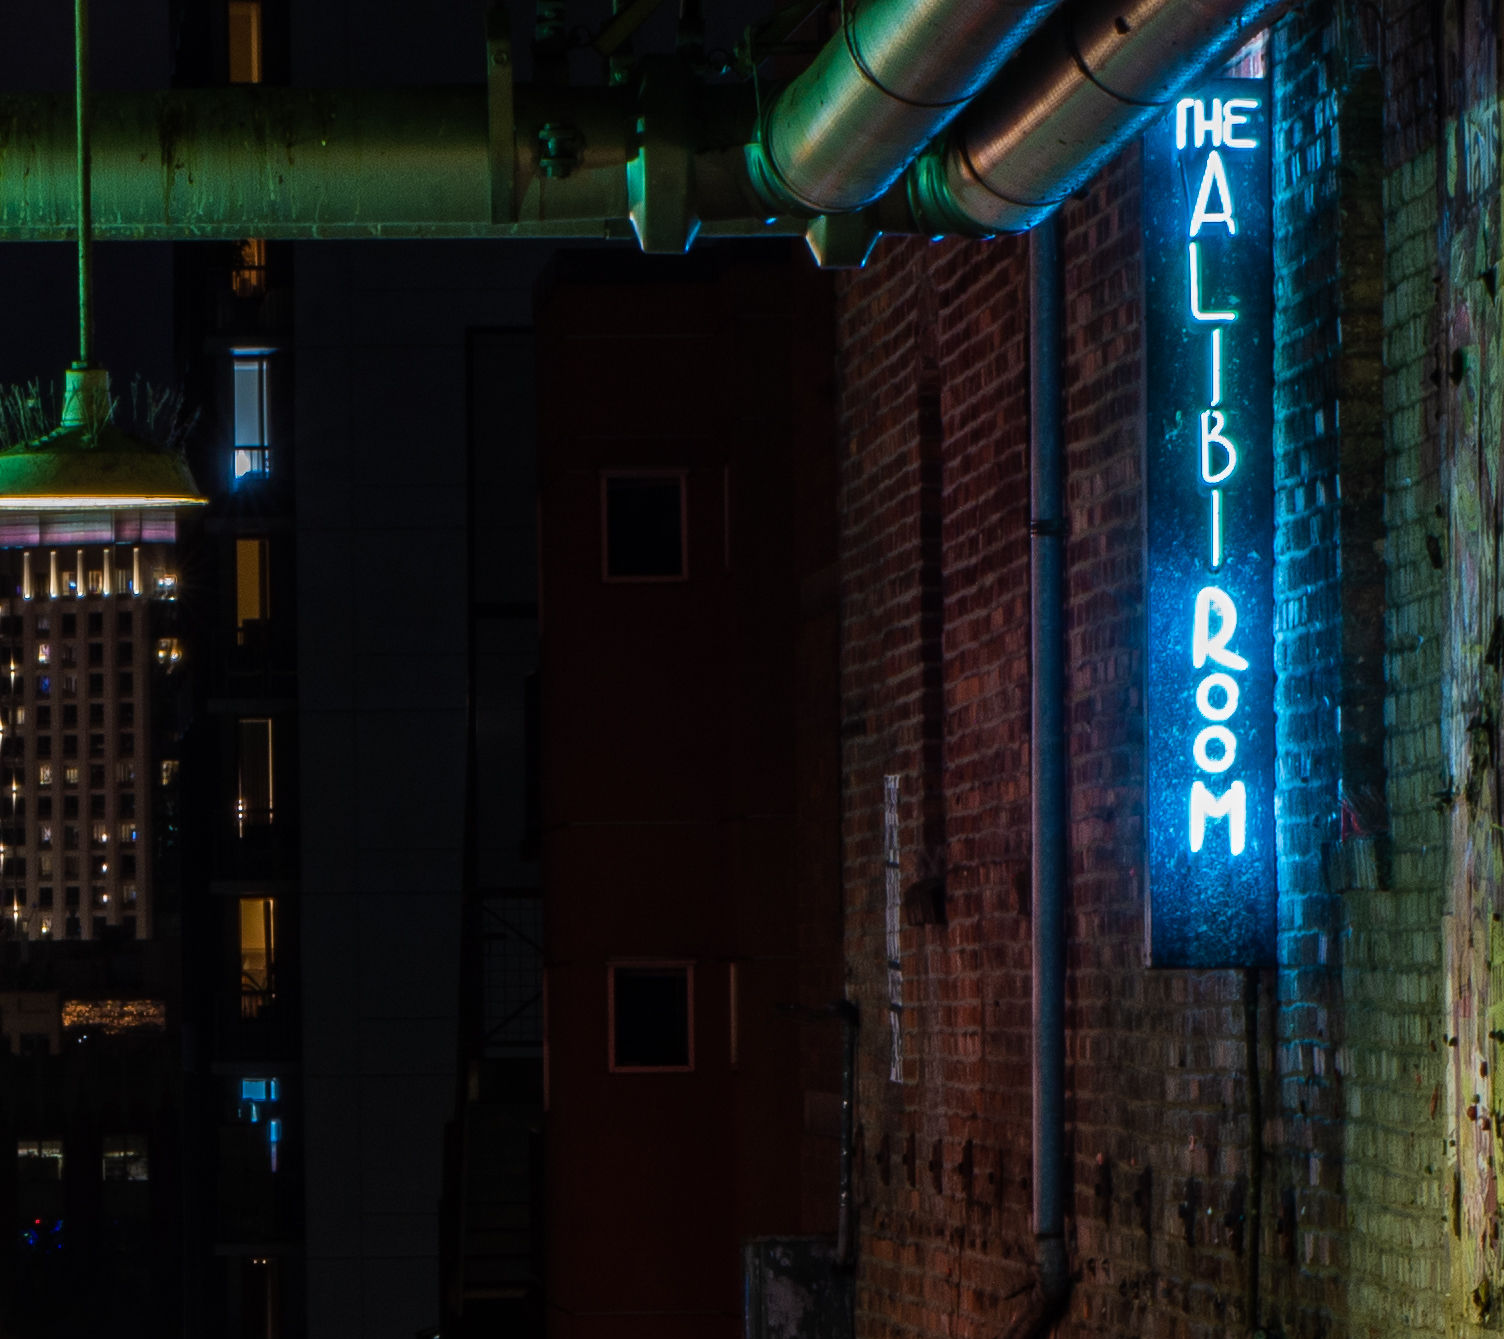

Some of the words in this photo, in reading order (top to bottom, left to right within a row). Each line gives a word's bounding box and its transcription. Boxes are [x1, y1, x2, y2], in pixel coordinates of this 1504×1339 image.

[1176, 97, 1258, 150] THE
[1189, 151, 1237, 567] ALIBI
[1190, 585, 1250, 857] ROOM
